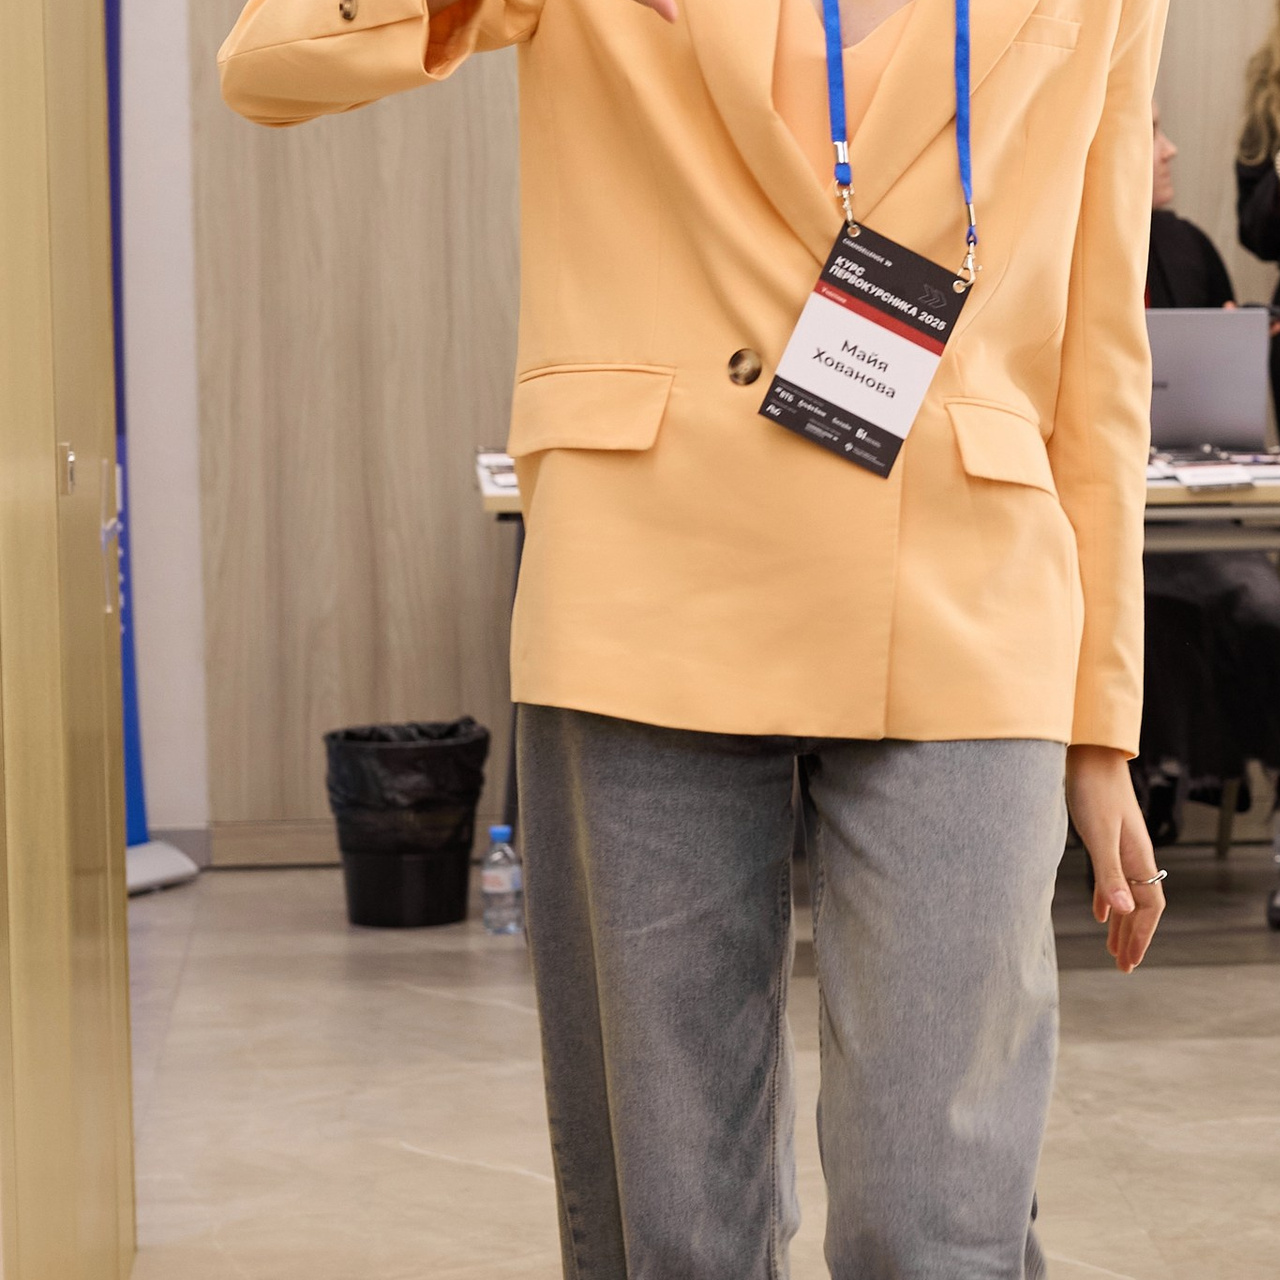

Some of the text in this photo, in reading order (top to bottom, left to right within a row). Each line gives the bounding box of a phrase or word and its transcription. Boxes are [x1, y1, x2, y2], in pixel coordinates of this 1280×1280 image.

[834, 255, 866, 277] КУРС
[828, 264, 947, 332] ПЕРВОКУРСНИКА 2025
[812, 347, 896, 400] Хованова
[840, 339, 889, 373] Майя
